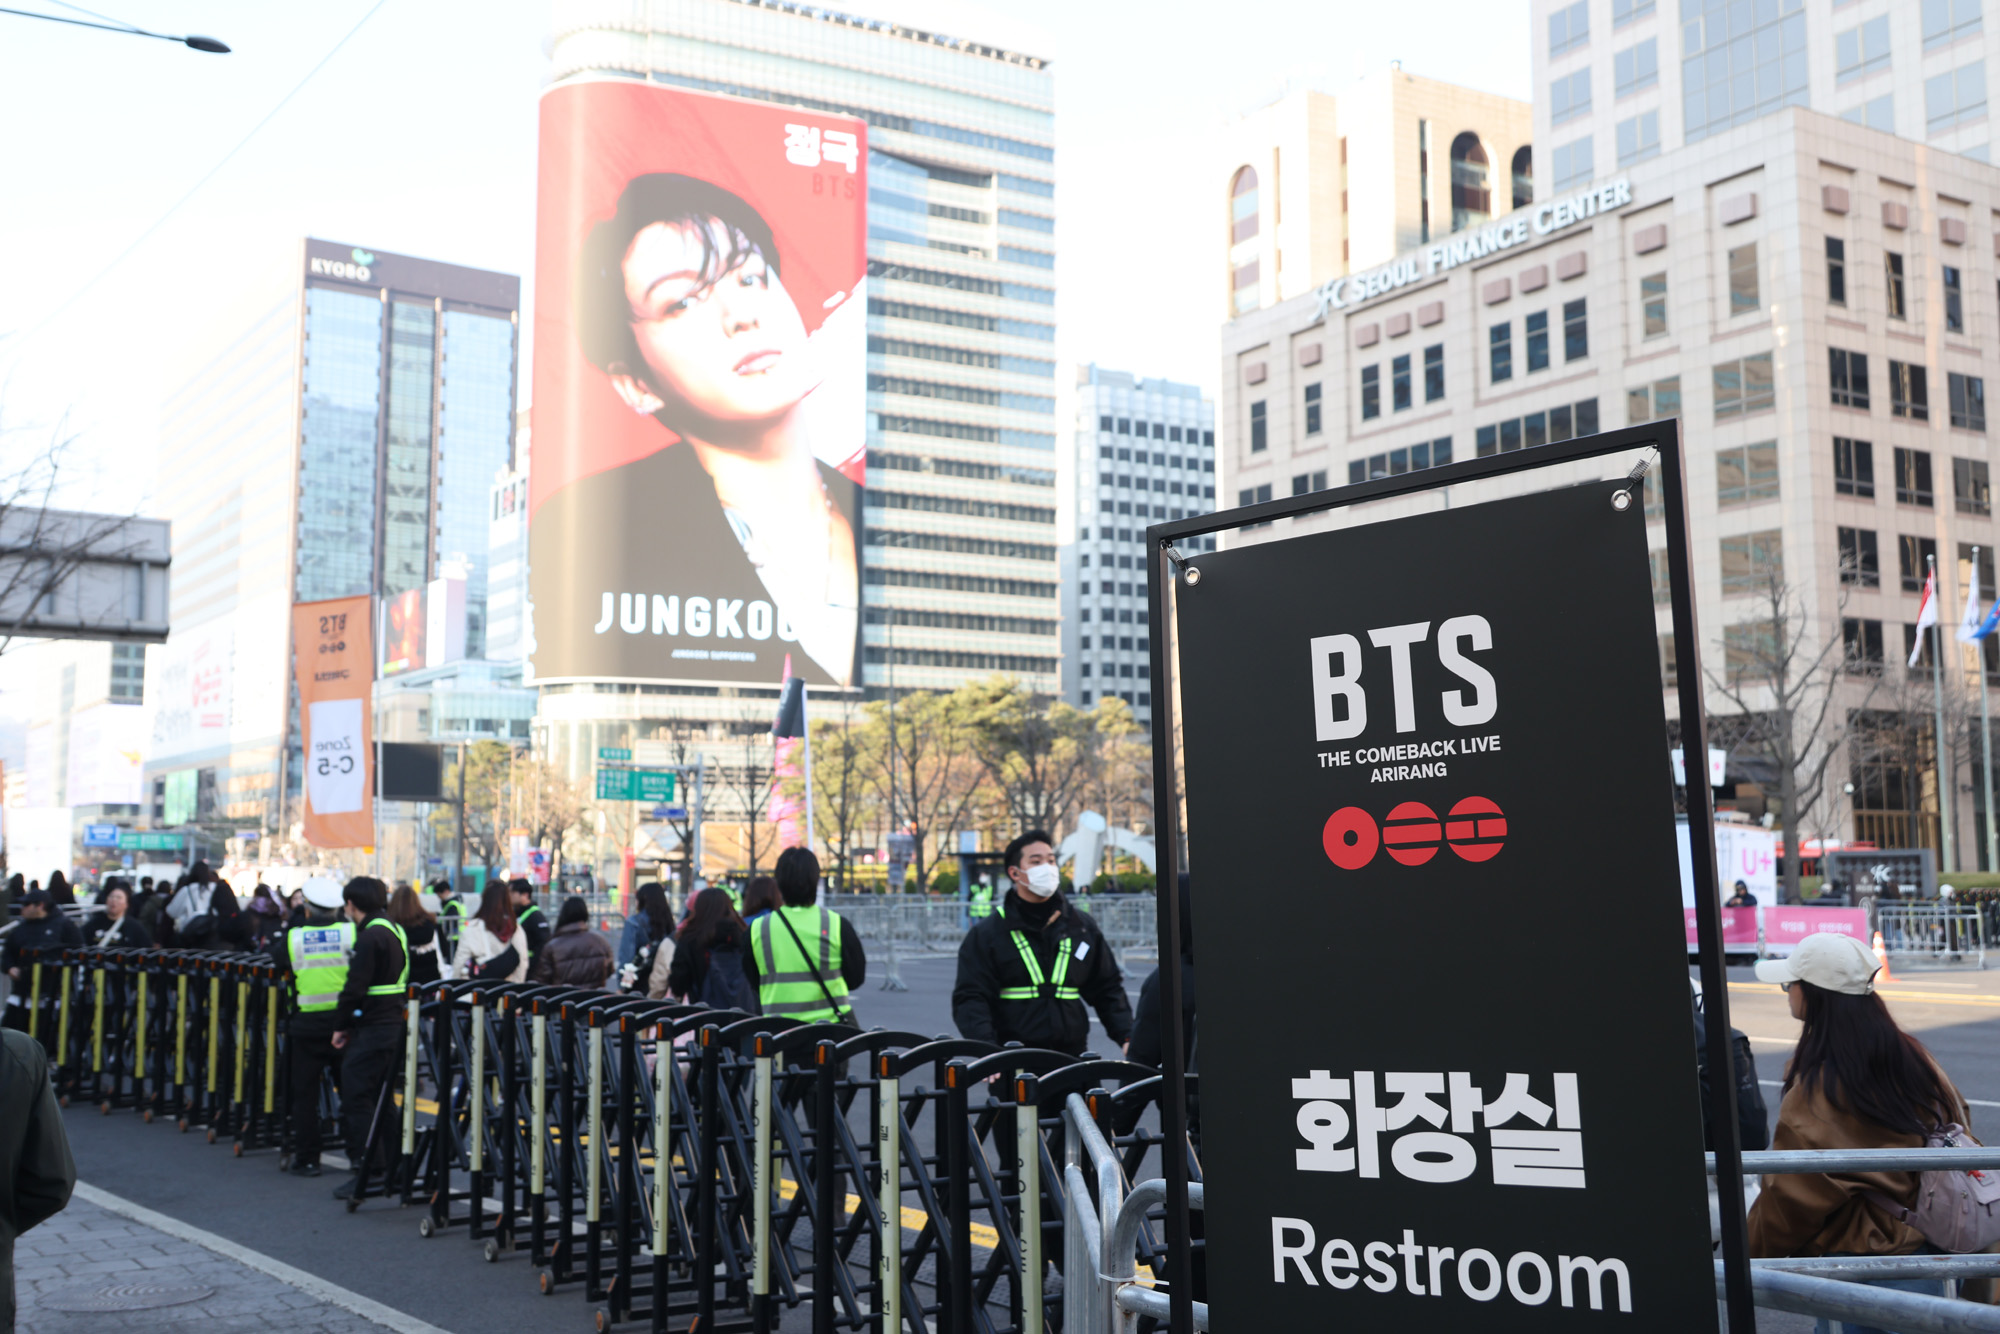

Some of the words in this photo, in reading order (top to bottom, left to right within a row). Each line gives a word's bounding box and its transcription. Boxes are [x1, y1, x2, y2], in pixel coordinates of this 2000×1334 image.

[812, 173, 856, 200] BTS
[311, 257, 371, 282] KYOBO
[1351, 256, 1423, 302] SEOUL
[1427, 217, 1528, 275] FINANCE
[1532, 179, 1632, 235] CENTER
[1310, 614, 1498, 742] BTS
[1317, 751, 1351, 768] THE
[1355, 740, 1456, 764] COMEBACK
[1461, 735, 1501, 754] LIVE
[1370, 762, 1448, 783] ARIRANG
[1291, 1069, 1586, 1188] 화장실
[1271, 1216, 1633, 1313] Restroom
